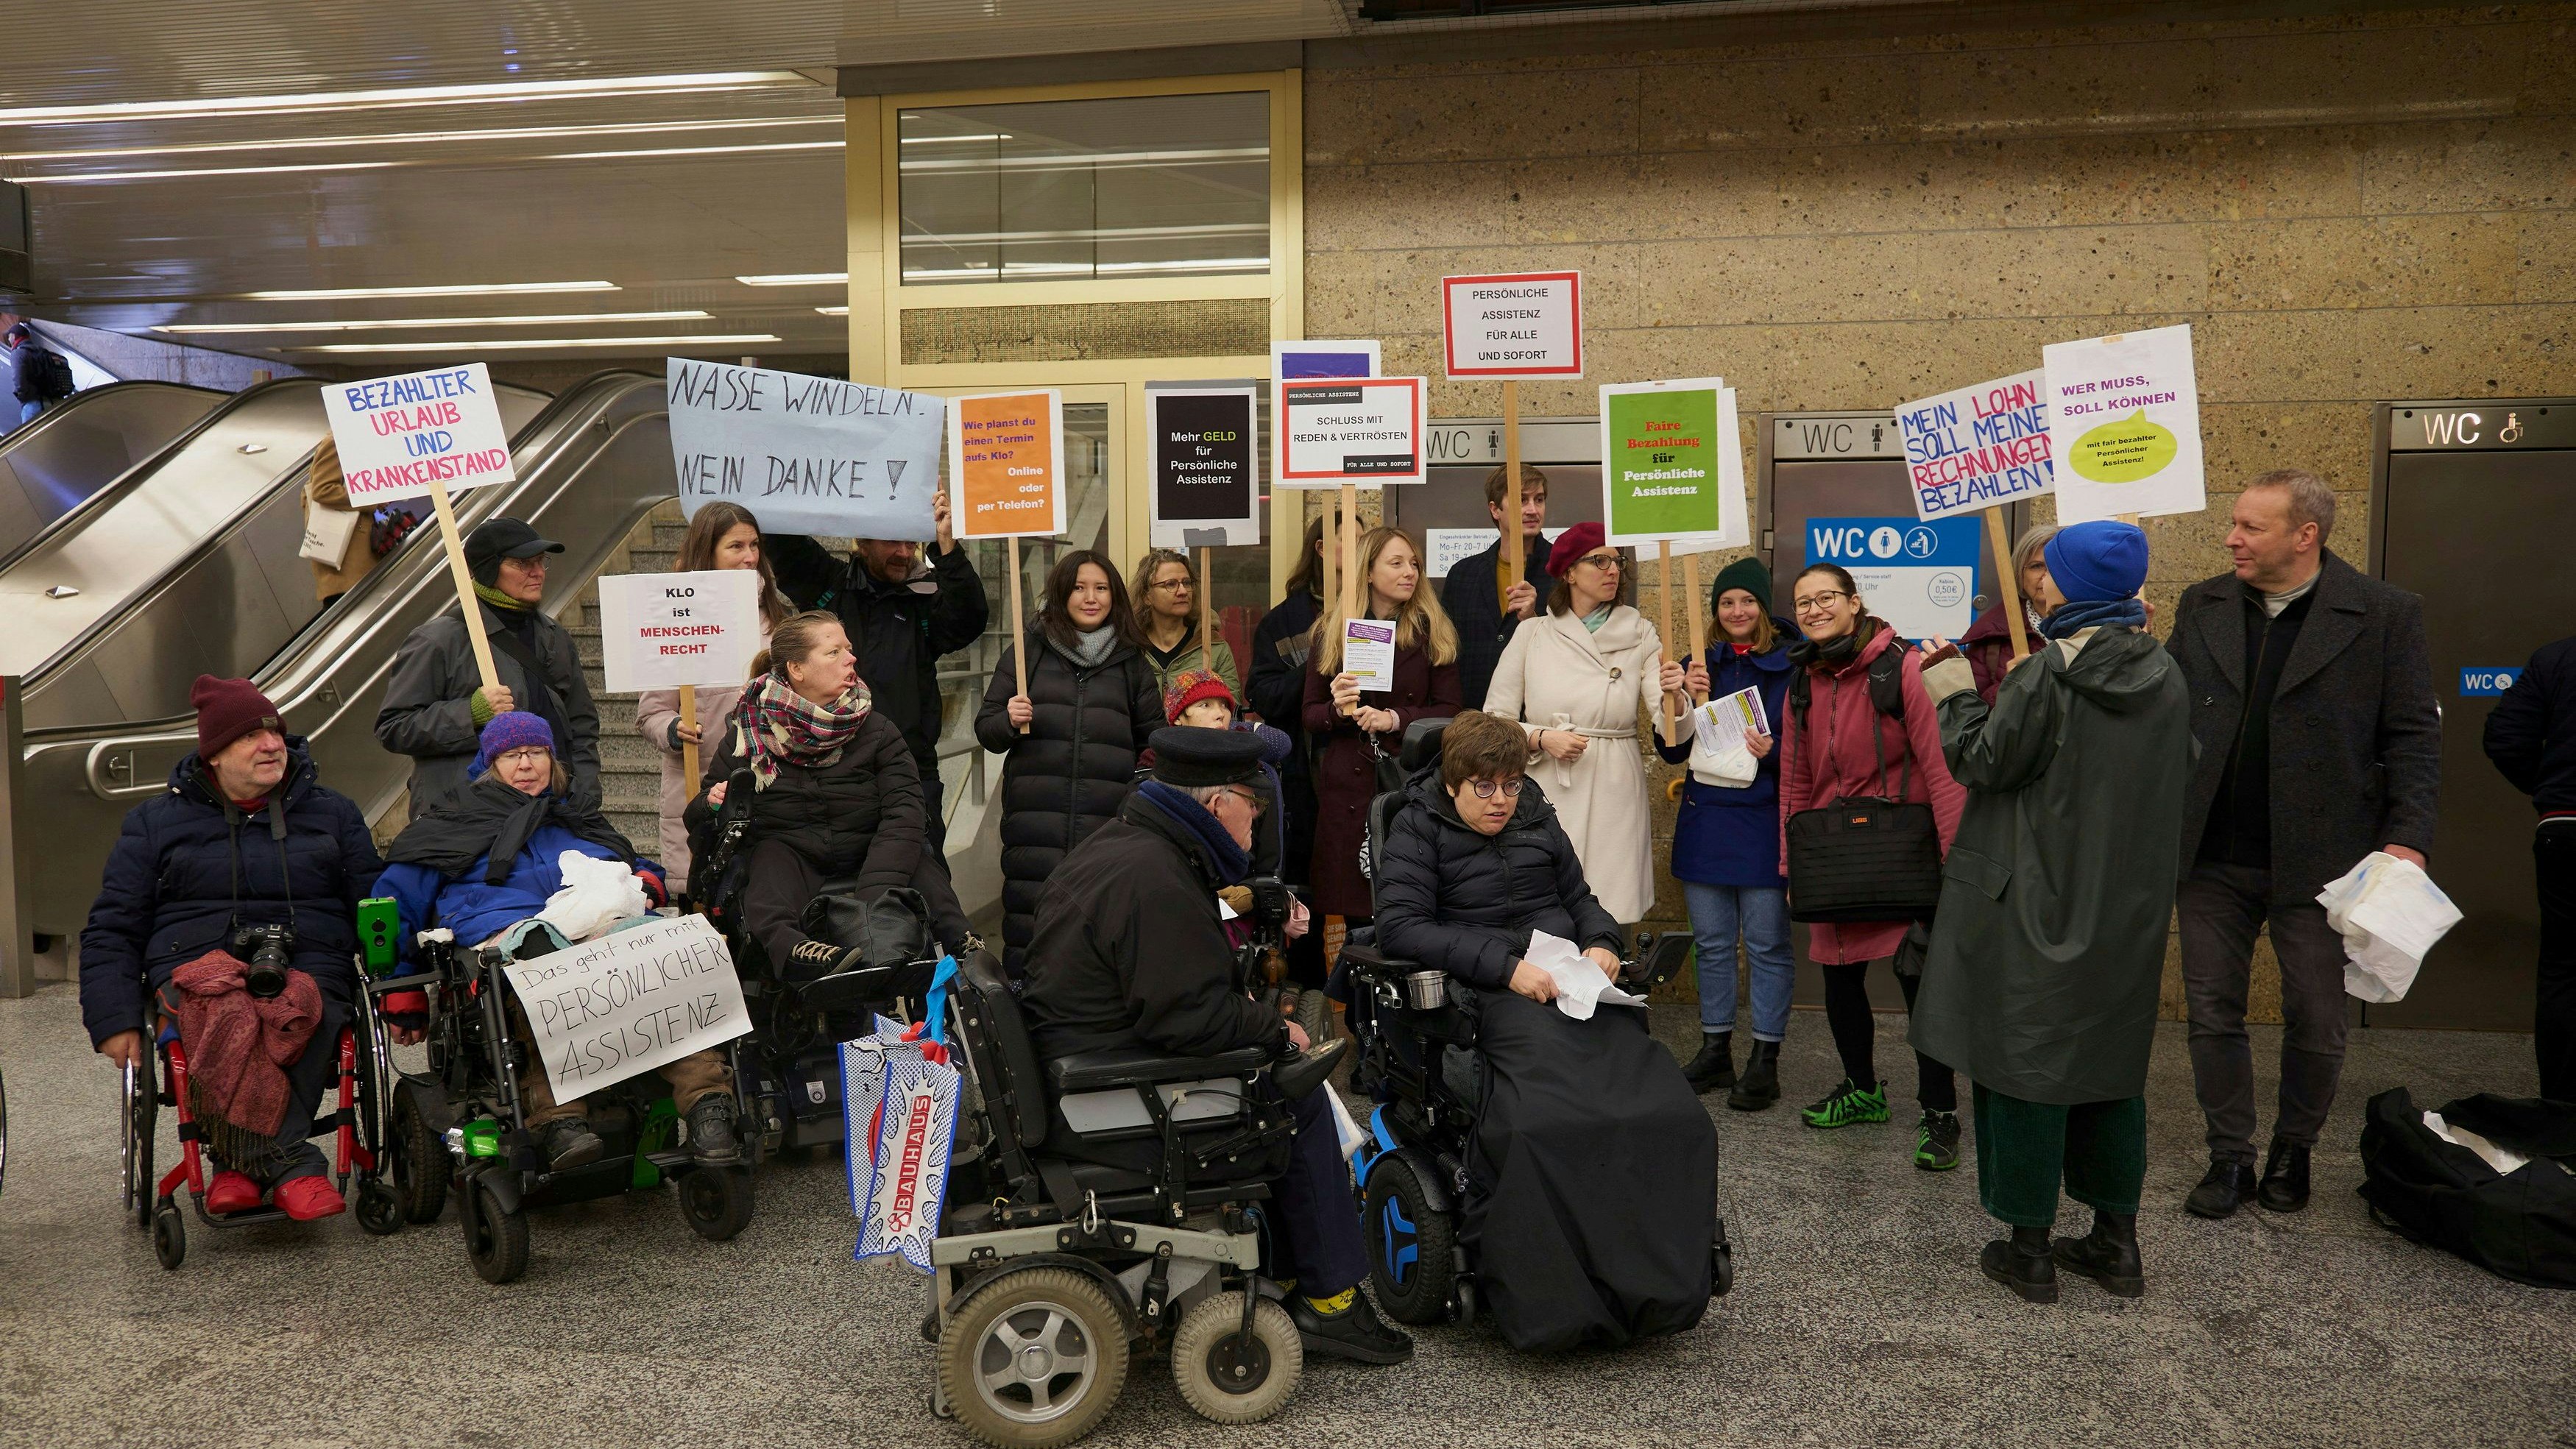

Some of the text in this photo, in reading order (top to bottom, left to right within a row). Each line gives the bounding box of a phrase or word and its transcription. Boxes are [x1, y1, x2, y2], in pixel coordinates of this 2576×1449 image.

[1472, 287, 1549, 300] PERSÖNLICHE
[1482, 308, 1540, 320] ASSISTENZ
[1485, 327, 1538, 339] FÜR ALLE
[1479, 350, 1547, 361] UND SOFORT
[345, 369, 475, 411] BEZAHLTER
[670, 363, 768, 411] NASSE
[2062, 376, 2150, 396] WER MUSS,
[1901, 380, 2037, 437] MEIN LOHN
[2064, 392, 2176, 416] SOLL KÖNNEN
[370, 402, 461, 436] URLAUB
[963, 417, 1036, 431] Wie planst du
[1317, 416, 1383, 425] SCHLUSS MIT
[1646, 420, 1681, 433] Faire
[2424, 412, 2481, 444] WC
[964, 433, 1034, 446] einen Termin
[1171, 431, 1236, 442] Mehr GELD
[1293, 430, 1407, 443] REDEN & VERTRÖSTEN
[1803, 425, 1852, 453] WC
[1906, 403, 2050, 464] SOLL MEINE
[404, 431, 452, 457] UND
[1426, 431, 1471, 458] WC
[1627, 434, 1700, 450] Bezahlung
[2102, 439, 2116, 447] fair
[2118, 434, 2156, 445] bezahlter
[965, 450, 1013, 462] aufs Klo?
[1195, 444, 1212, 456] für
[2097, 445, 2148, 457] Persönlicher
[1170, 458, 1237, 470] Persönliche
[1653, 452, 1674, 464] für
[1913, 433, 2052, 490] RECHNUNGEN
[2103, 456, 2144, 467] Assistenz!
[347, 449, 506, 494] KRANKENSTAND
[682, 454, 744, 495] NEIN
[762, 456, 867, 498] DANKE
[1008, 466, 1044, 476] Online
[1624, 467, 1705, 482] Persönliche
[1176, 473, 1232, 485] Assistenz
[1019, 483, 1044, 493] oder
[1632, 484, 1697, 497] Assistenz
[1919, 464, 2042, 514] BEZAHLEN
[977, 499, 1044, 514] per Telefon?
[1814, 527, 1864, 558] WC
[665, 588, 695, 598] KLO
[1865, 583, 1878, 591] Uhr
[1936, 586, 1957, 594] 0,50€
[673, 606, 690, 617] ist
[640, 625, 724, 638] MENSCHEN-
[659, 642, 707, 655] RECHT
[2465, 673, 2493, 690] WC
[518, 919, 699, 990] Das geht nur mit
[537, 938, 729, 1038] PERSÖNLICHER
[558, 993, 726, 1085] ASSISTENZ
[895, 1097, 930, 1210] BAUHAUS
